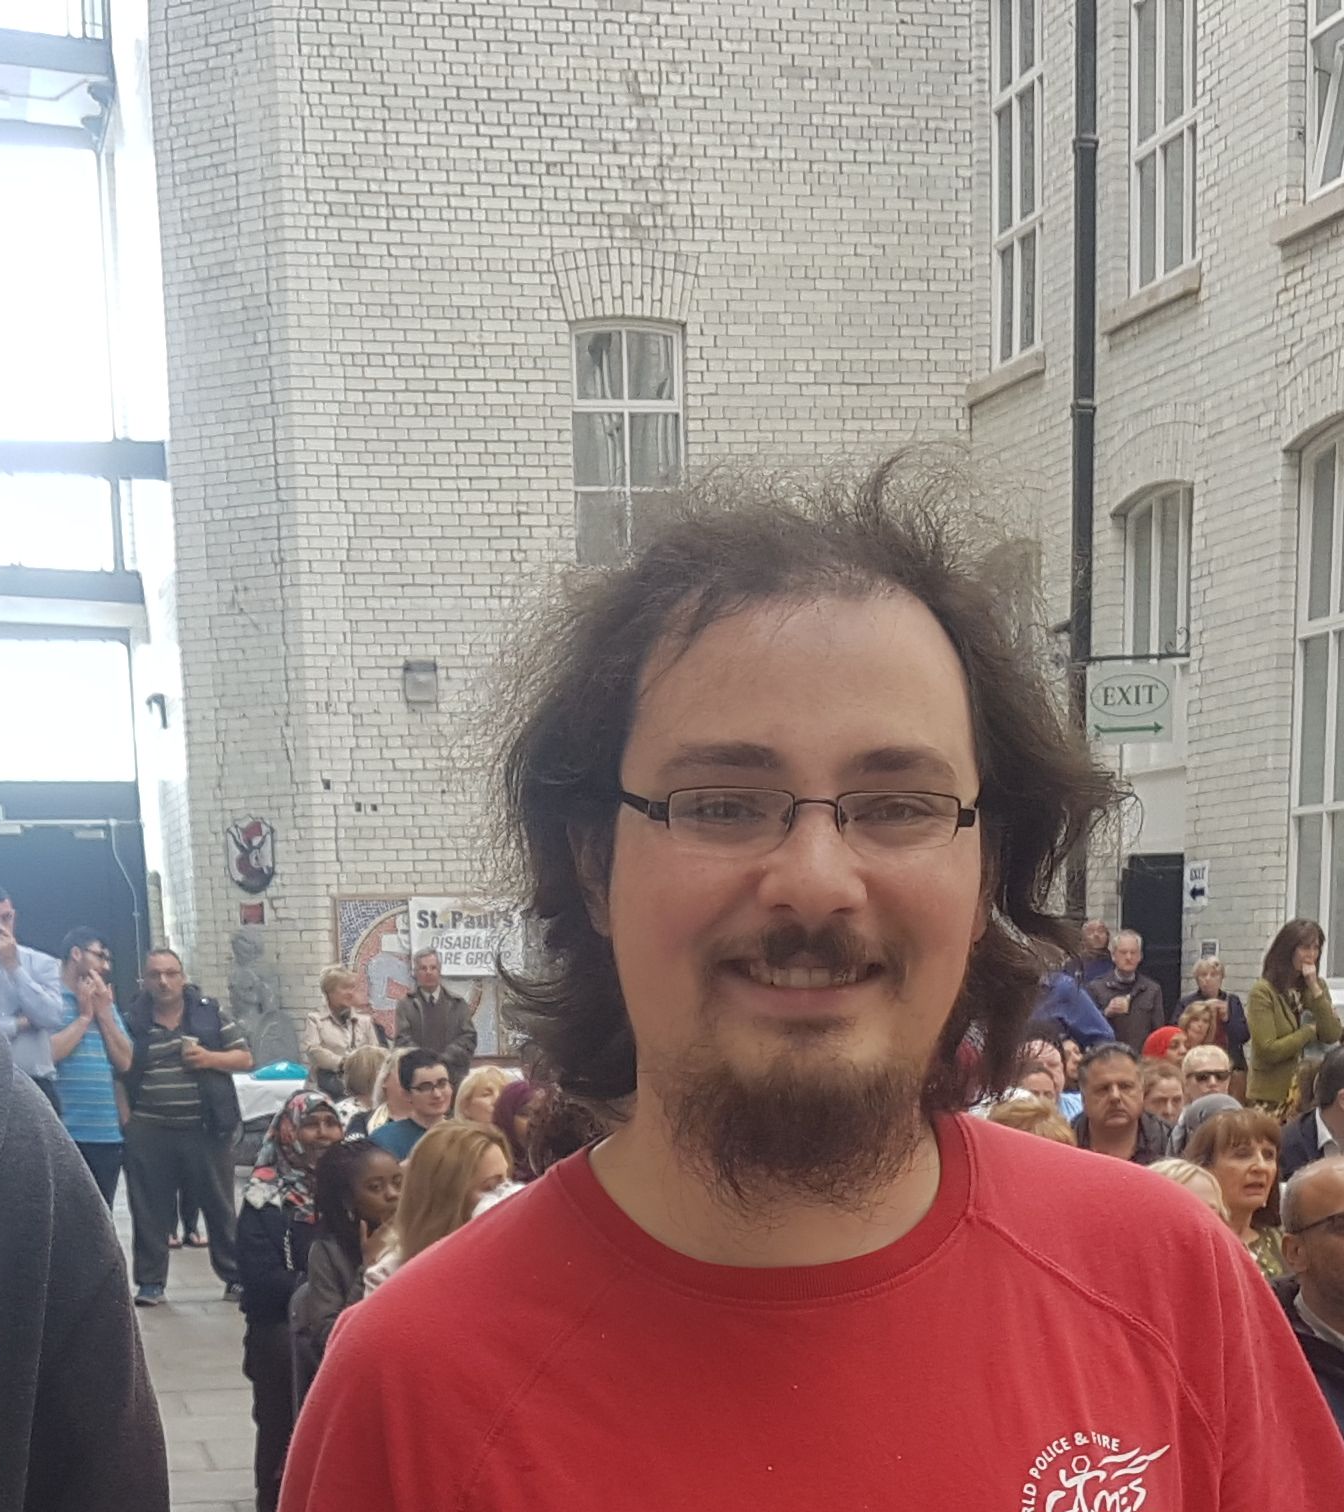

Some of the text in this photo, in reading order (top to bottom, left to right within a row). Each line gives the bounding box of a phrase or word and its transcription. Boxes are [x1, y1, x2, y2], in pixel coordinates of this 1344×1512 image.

[1103, 684, 1159, 706] EXIT
[417, 909, 444, 929] St.
[439, 951, 462, 966] ARE
[1029, 1437, 1072, 1479] POLICE
[1074, 1431, 1089, 1446] &
[1091, 1431, 1121, 1452] FIRE
